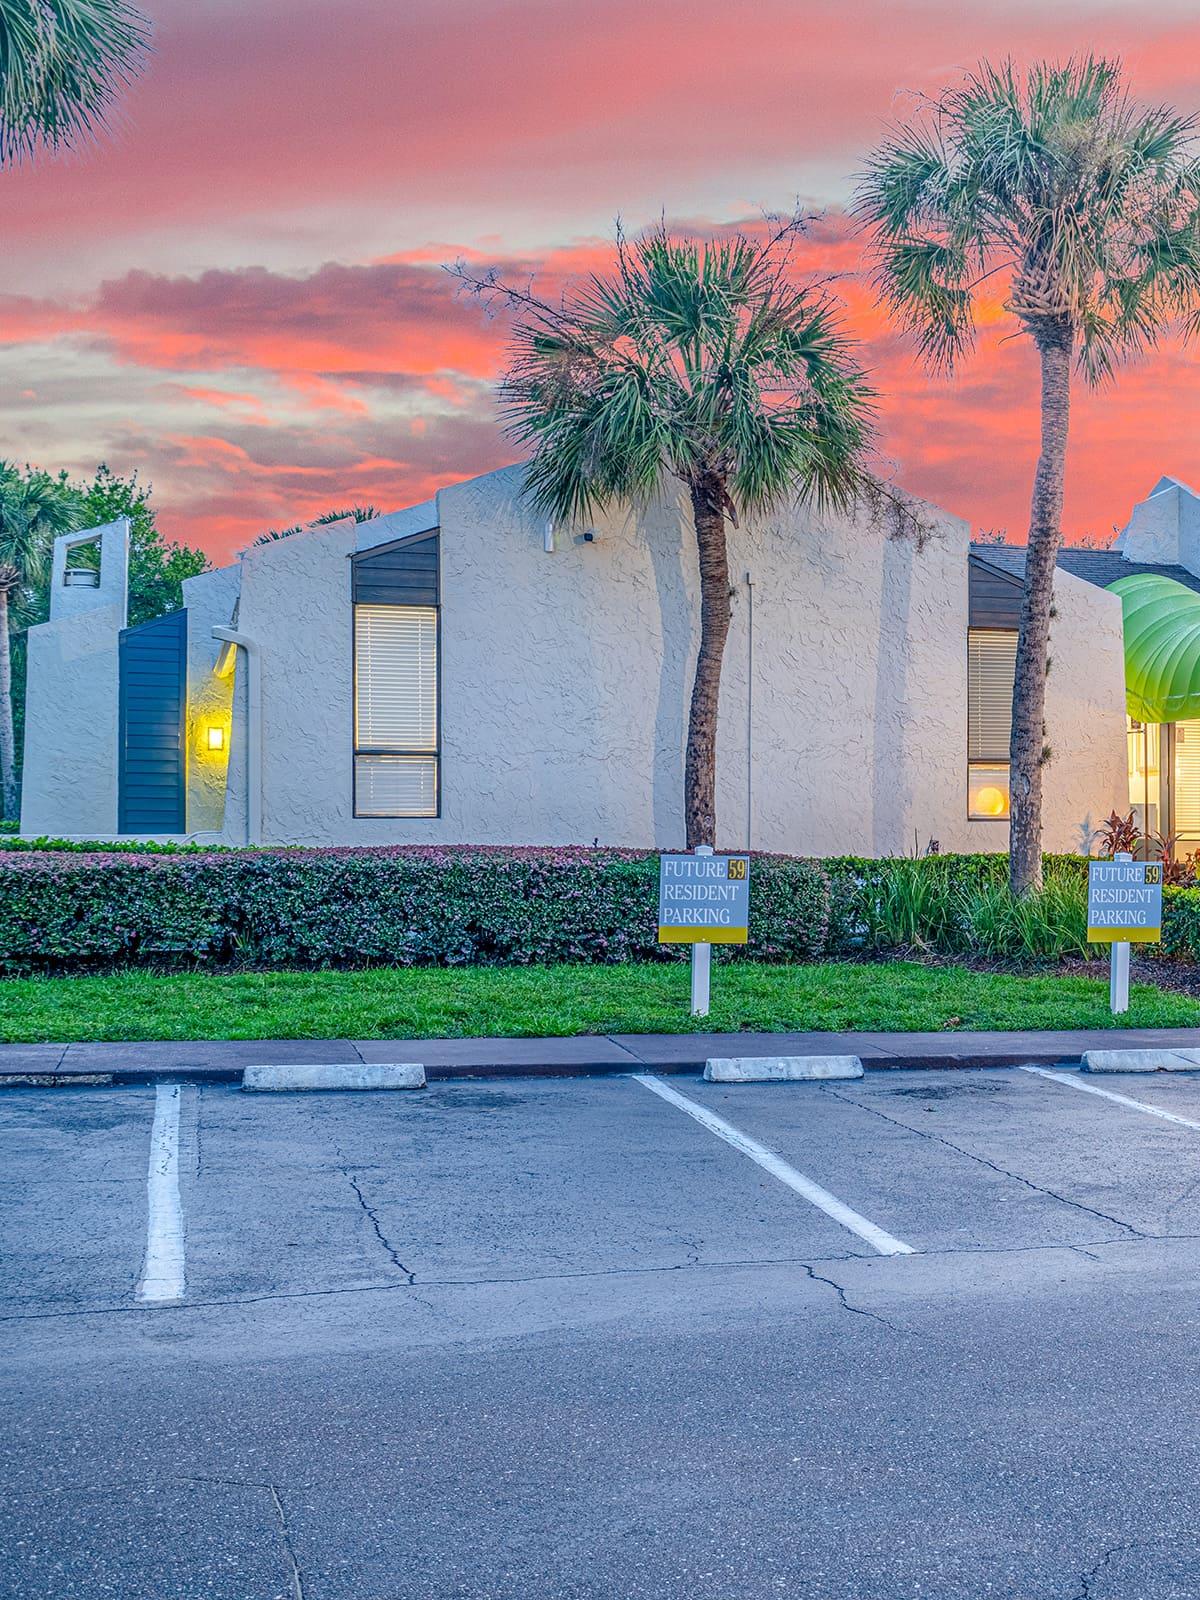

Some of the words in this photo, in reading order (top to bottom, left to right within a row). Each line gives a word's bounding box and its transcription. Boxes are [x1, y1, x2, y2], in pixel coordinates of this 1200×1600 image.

[664, 861, 725, 877] FUTURE
[729, 860, 745, 878] 59
[1092, 867, 1142, 882] FUTURE
[1145, 866, 1159, 883] 59
[664, 884, 739, 900] RESIDENT
[1092, 888, 1153, 903] RESIDENT
[663, 908, 730, 924] PARKING
[1091, 910, 1146, 925] PARKING
